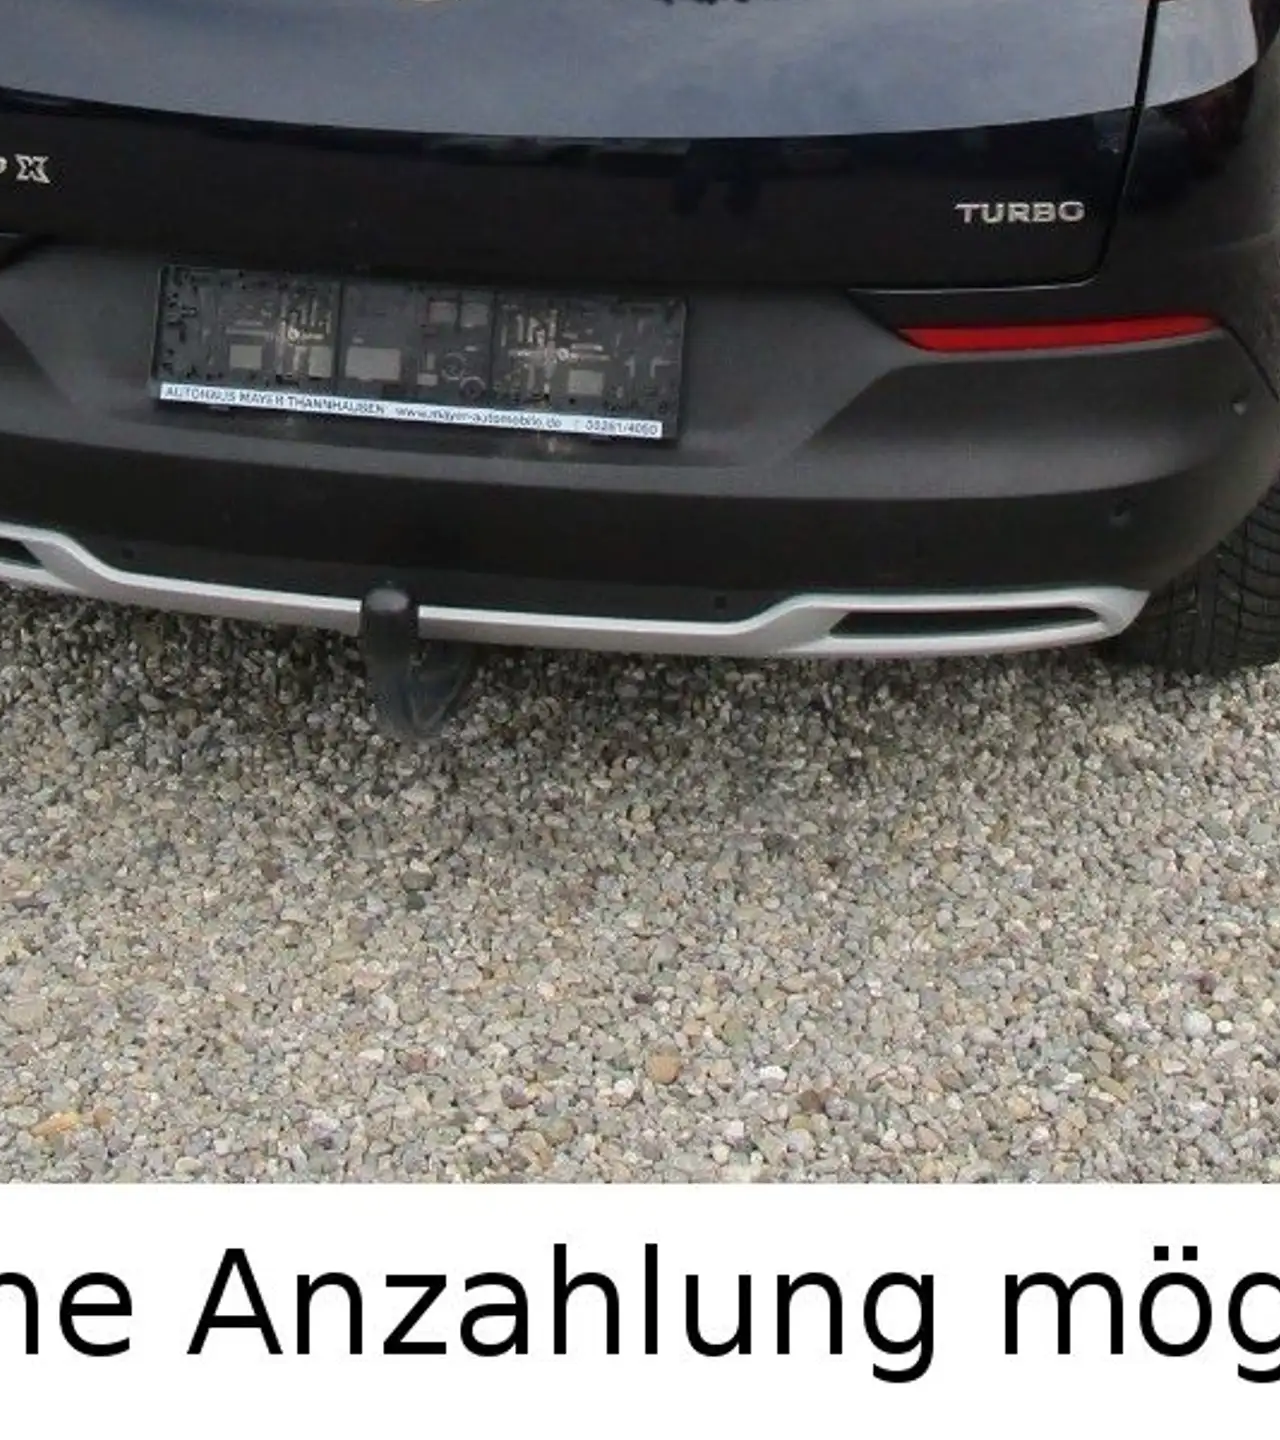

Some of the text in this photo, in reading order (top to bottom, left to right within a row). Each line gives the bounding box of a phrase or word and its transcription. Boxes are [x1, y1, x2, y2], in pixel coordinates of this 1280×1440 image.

[14, 153, 50, 184] X
[954, 201, 1086, 224] TURBO
[165, 386, 236, 403] AUTOHAUS
[239, 388, 283, 406] MAYER
